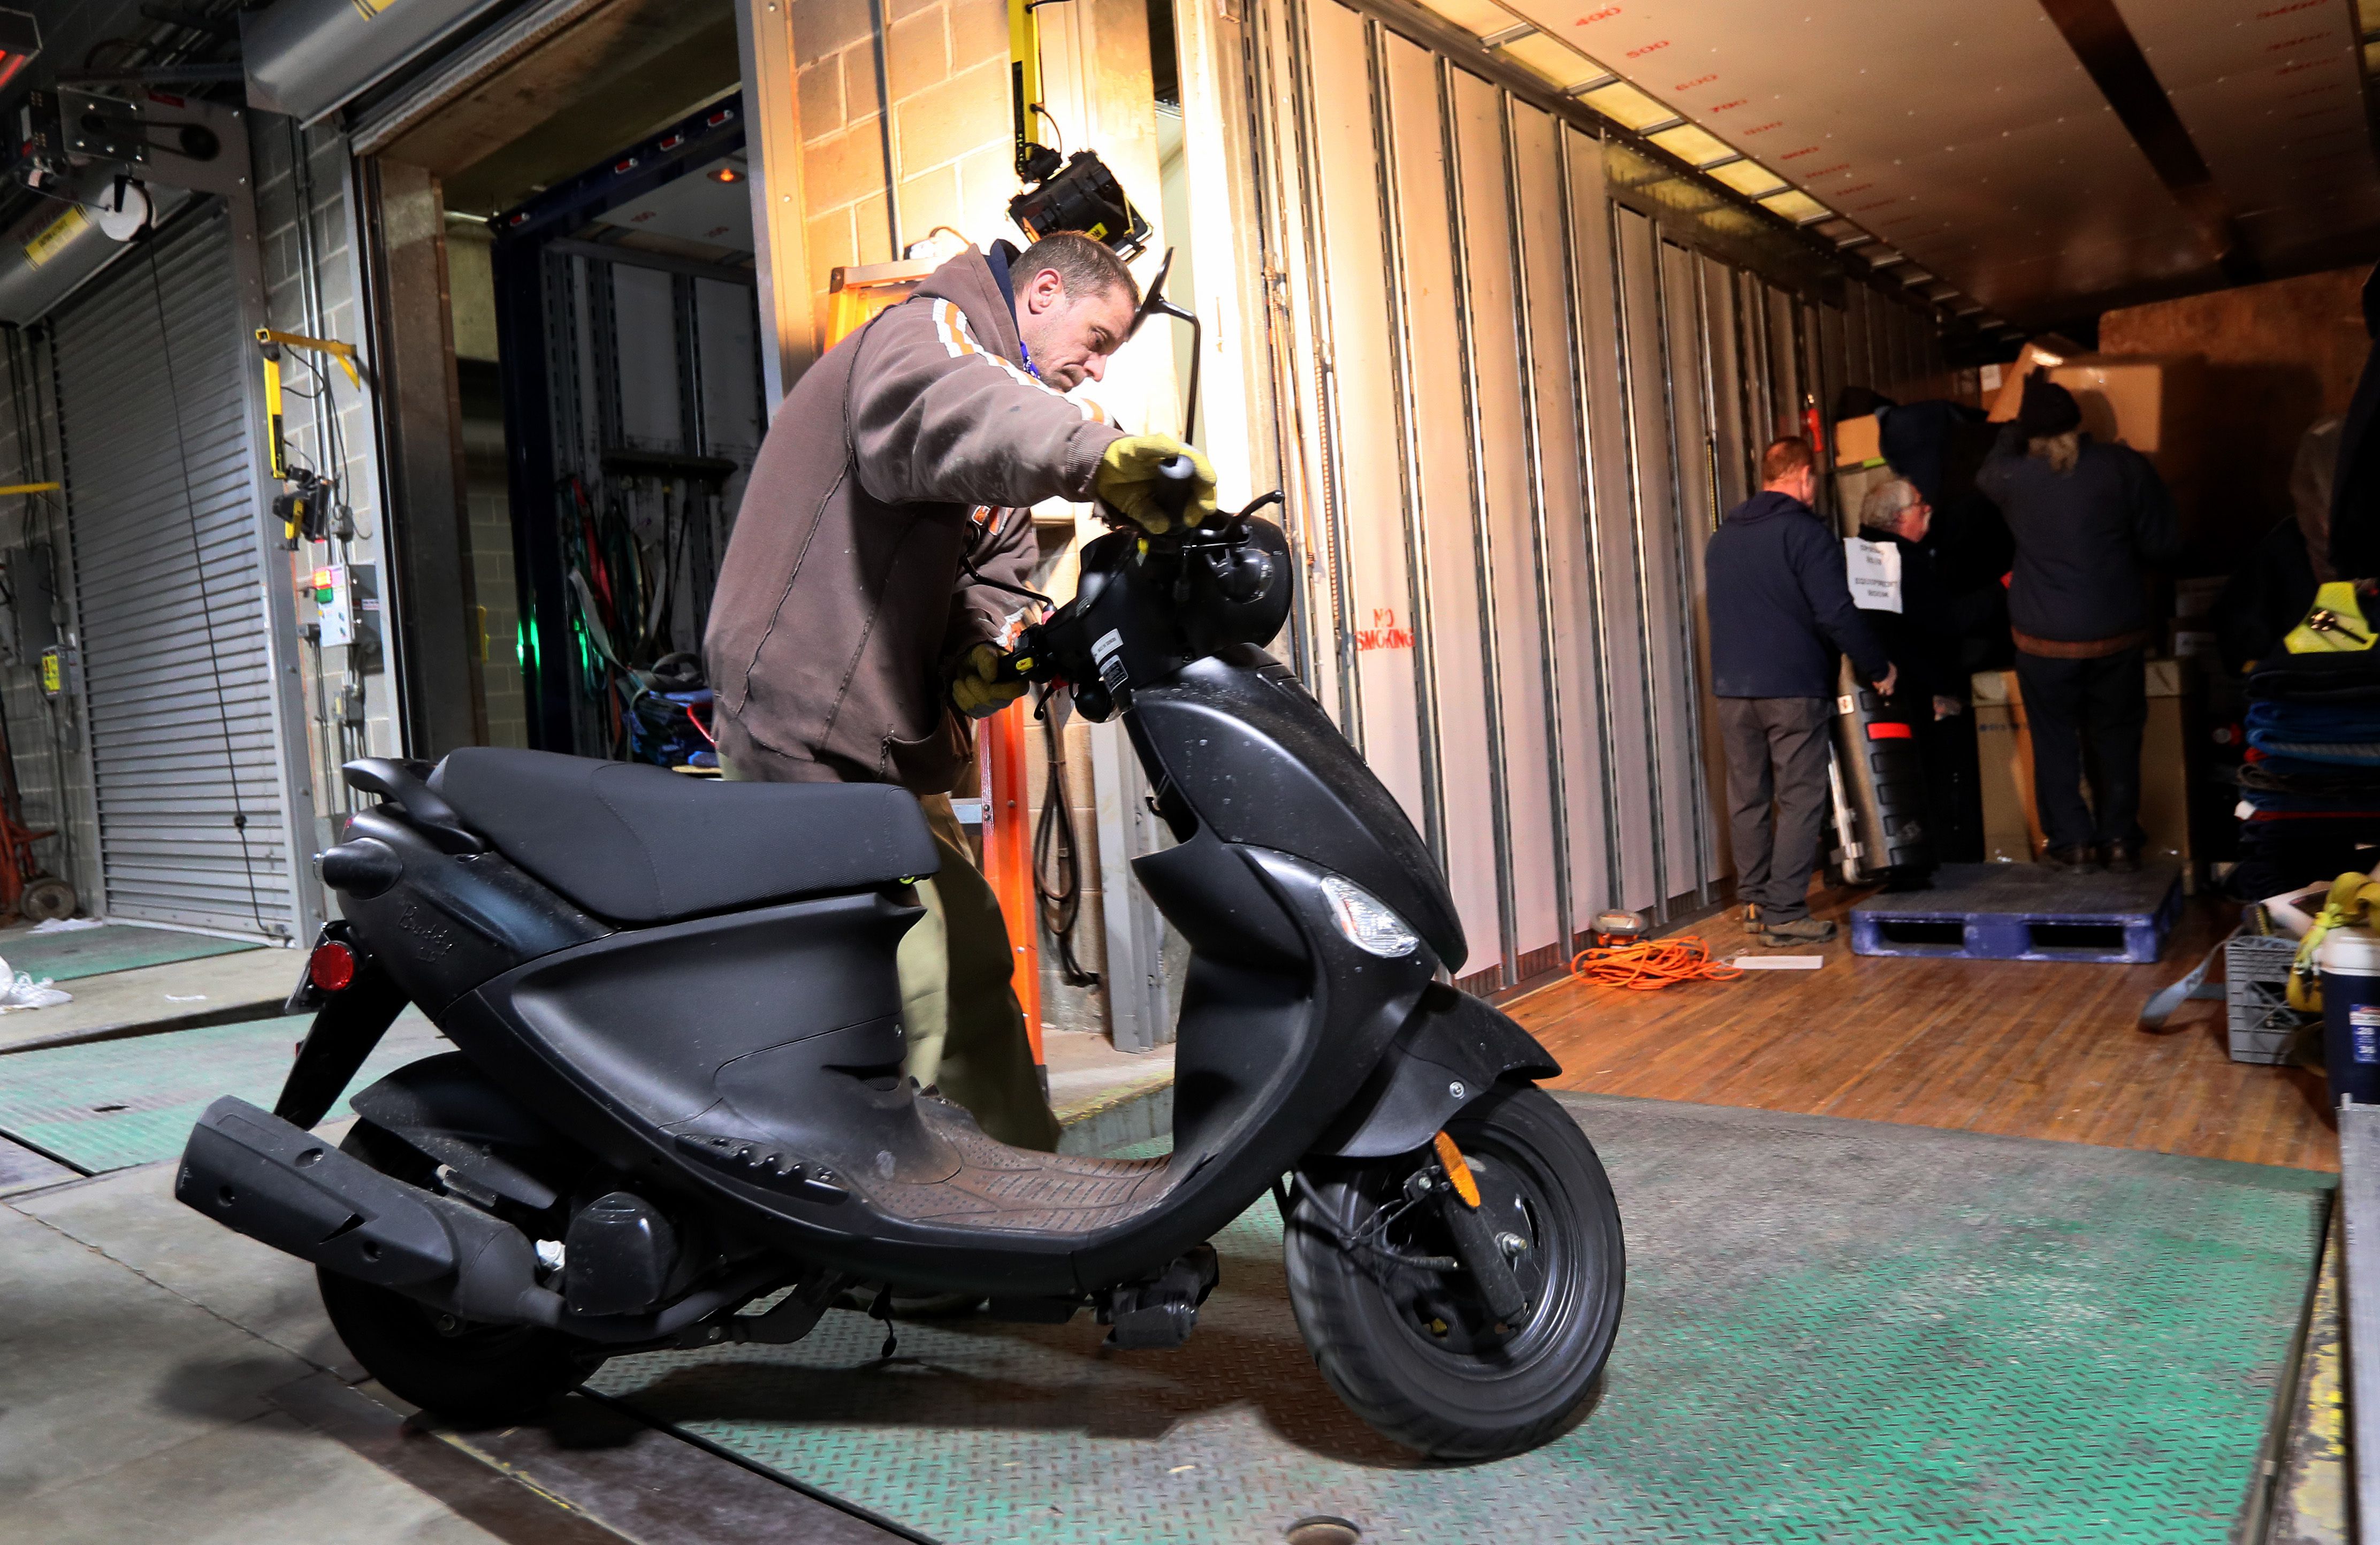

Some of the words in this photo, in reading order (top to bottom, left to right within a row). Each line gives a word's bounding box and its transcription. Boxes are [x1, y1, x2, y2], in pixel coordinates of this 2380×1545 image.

[1575, 7, 1621, 26] 400
[1626, 40, 1670, 58] 500
[1373, 608, 1394, 628] NO
[1356, 628, 1415, 651] SMOKING
[398, 904, 454, 958] Buddy
